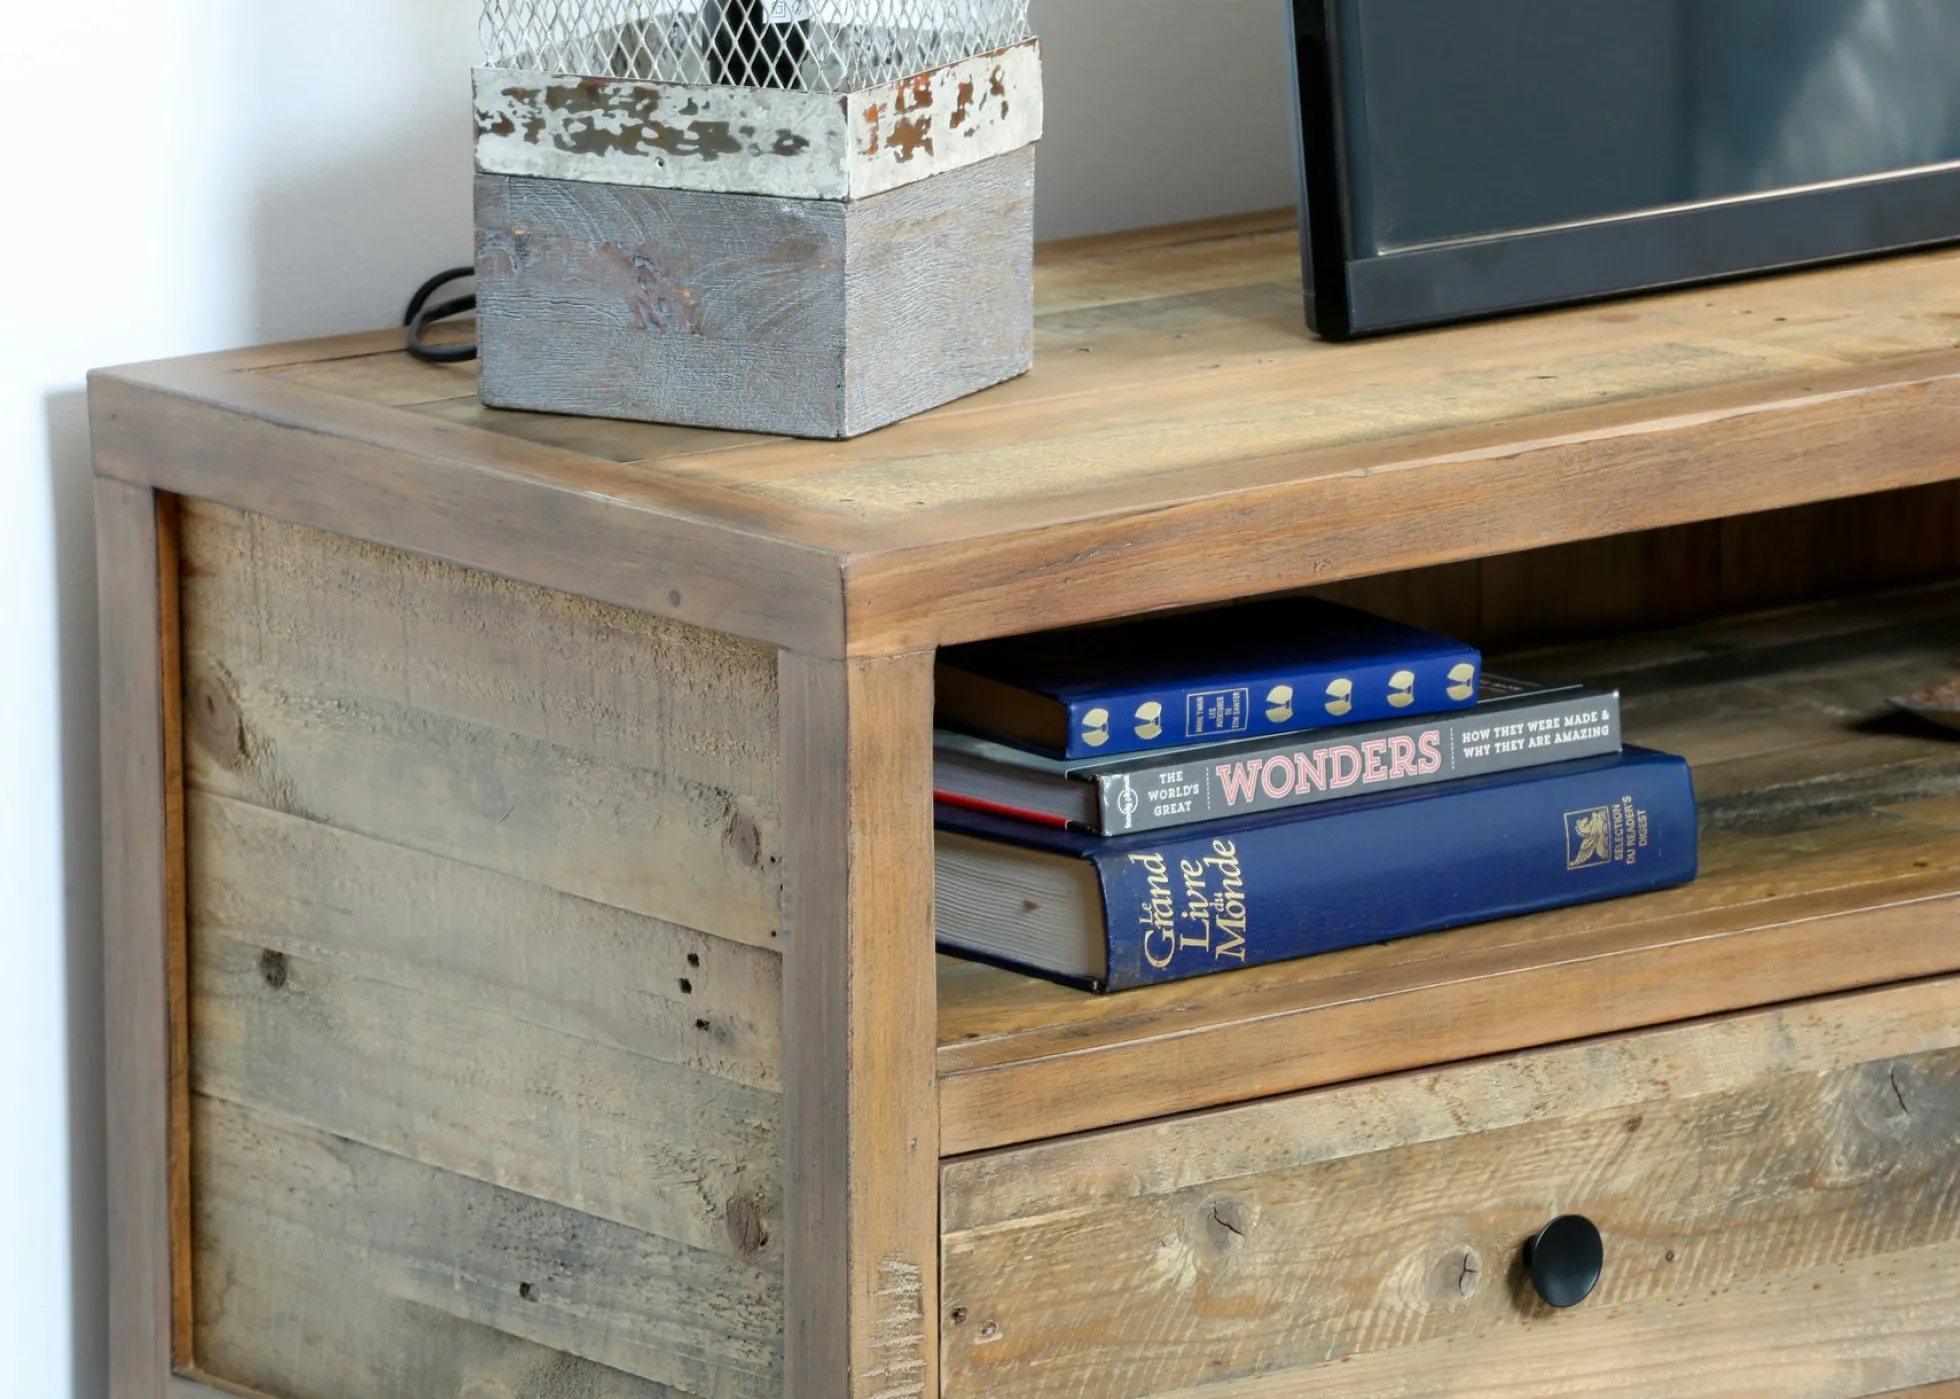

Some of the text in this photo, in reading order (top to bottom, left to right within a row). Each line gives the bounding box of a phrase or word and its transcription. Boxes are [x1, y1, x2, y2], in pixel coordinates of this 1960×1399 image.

[1462, 710, 1610, 743] HOW THEY WERE MADE &
[1463, 725, 1610, 758] WHY THEY ARE AMAZING
[1159, 771, 1183, 785] THE
[1216, 730, 1442, 806] WONDERS
[1148, 783, 1200, 802] WORLD'S
[1154, 801, 1192, 816] GREAT
[1612, 804, 1624, 861] SELECTION
[1622, 795, 1636, 865] DU READER'S
[1637, 809, 1648, 847] DIGEST
[1128, 852, 1175, 968] Grand
[1139, 902, 1153, 925] Le
[1179, 859, 1210, 953] Livre
[1203, 840, 1247, 962] Monde
[1209, 892, 1224, 912] du
